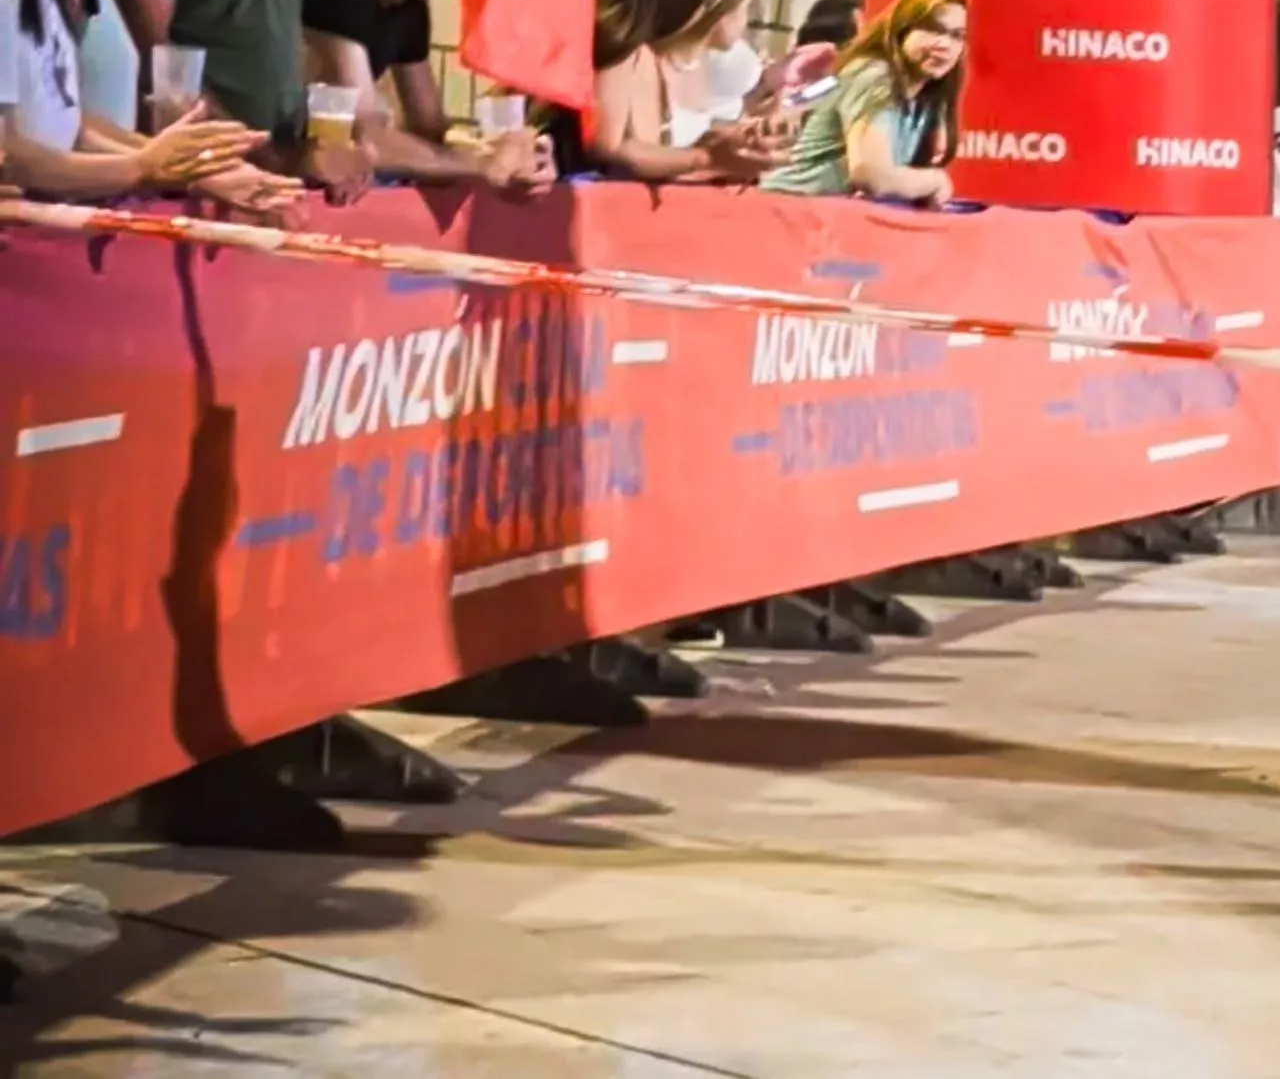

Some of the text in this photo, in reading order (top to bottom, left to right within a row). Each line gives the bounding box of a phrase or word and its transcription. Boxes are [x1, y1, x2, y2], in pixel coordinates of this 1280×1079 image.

[1040, 28, 1169, 62] HINACO
[1136, 136, 1240, 169] HINACO
[282, 293, 502, 450] MONZÓN
